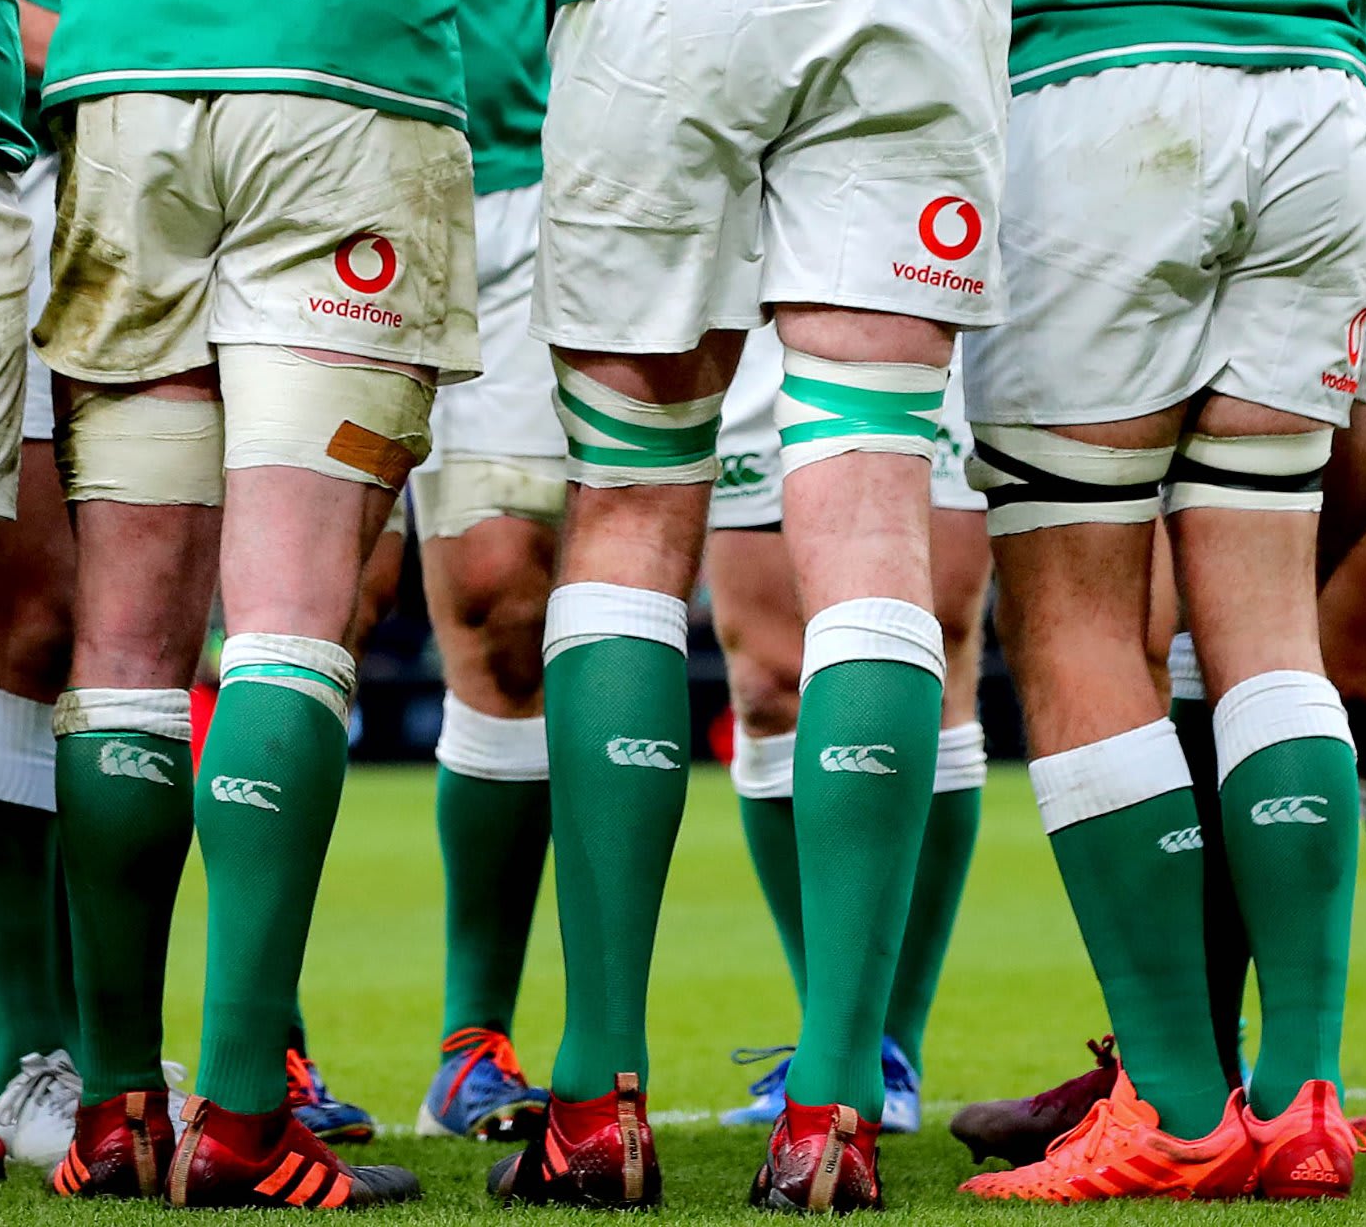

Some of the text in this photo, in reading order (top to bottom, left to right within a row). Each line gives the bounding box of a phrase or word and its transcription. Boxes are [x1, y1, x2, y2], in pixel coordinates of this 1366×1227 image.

[892, 261, 985, 295] vodafone
[308, 297, 403, 328] vodafone
[1290, 1169, 1340, 1184] adidas
